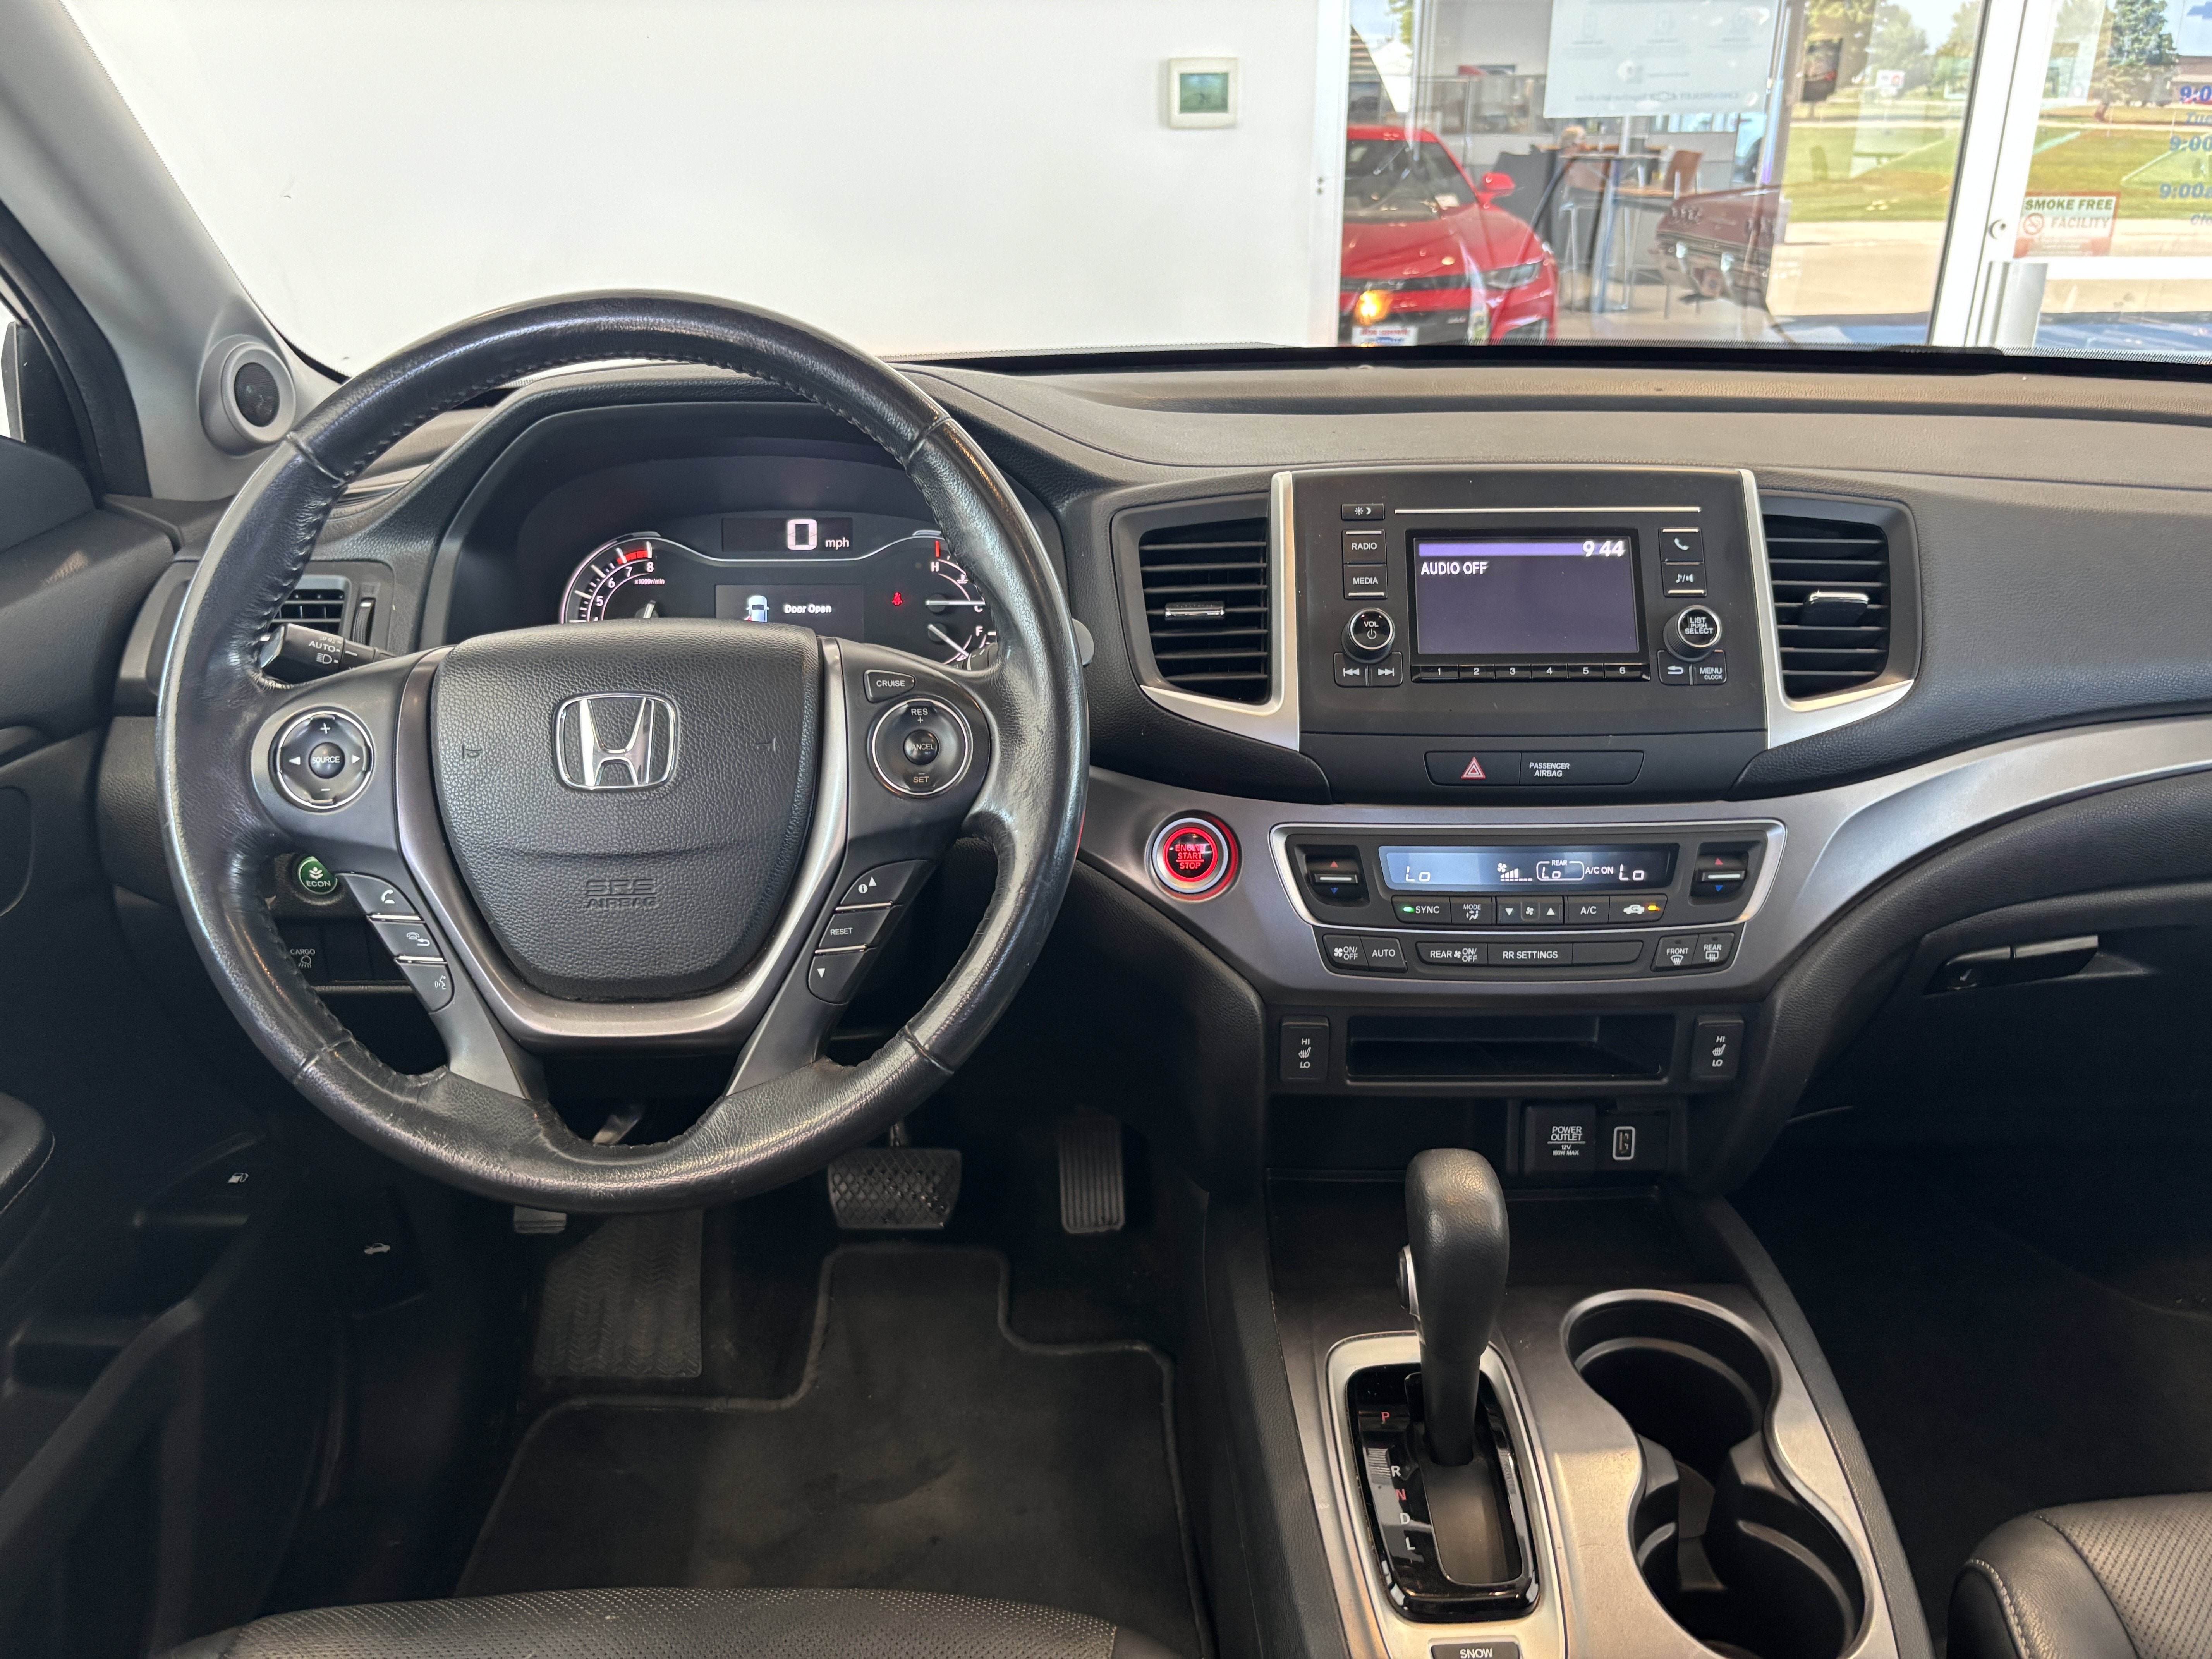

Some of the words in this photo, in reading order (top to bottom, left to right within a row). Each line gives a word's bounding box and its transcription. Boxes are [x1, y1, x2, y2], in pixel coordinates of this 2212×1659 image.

[2025, 199, 2075, 210] SMOKE
[2078, 199, 2113, 210] FREE
[2051, 218, 2110, 228] FACILITY
[788, 519, 817, 550] 0
[825, 537, 850, 550] mph
[626, 567, 632, 577] 7
[647, 562, 654, 572] 8
[931, 562, 939, 572] H
[1421, 562, 1460, 575] AUDIO
[1463, 562, 1489, 575] OFF
[608, 578, 615, 588] 6
[596, 596, 603, 606] 5
[784, 605, 807, 613] Door
[808, 605, 831, 613] Open
[975, 626, 983, 636] F
[309, 641, 335, 653] AUTO
[1546, 667, 1553, 675] 4
[1405, 866, 1431, 882] Lo
[1542, 867, 1561, 879] Lo
[1619, 864, 1644, 881] Lo
[586, 878, 654, 894] SRS
[587, 897, 656, 908] AIRBAG
[1415, 905, 1439, 914] SYNC
[1580, 906, 1597, 914] A/C
[1516, 951, 1558, 959] SETTINGS
[1381, 1412, 1390, 1422] P
[1391, 1466, 1401, 1477] R
[1395, 1489, 1406, 1500] N
[1400, 1512, 1410, 1525] D
[1405, 1537, 1415, 1550] L
[1460, 1648, 1492, 1659] SNOW
